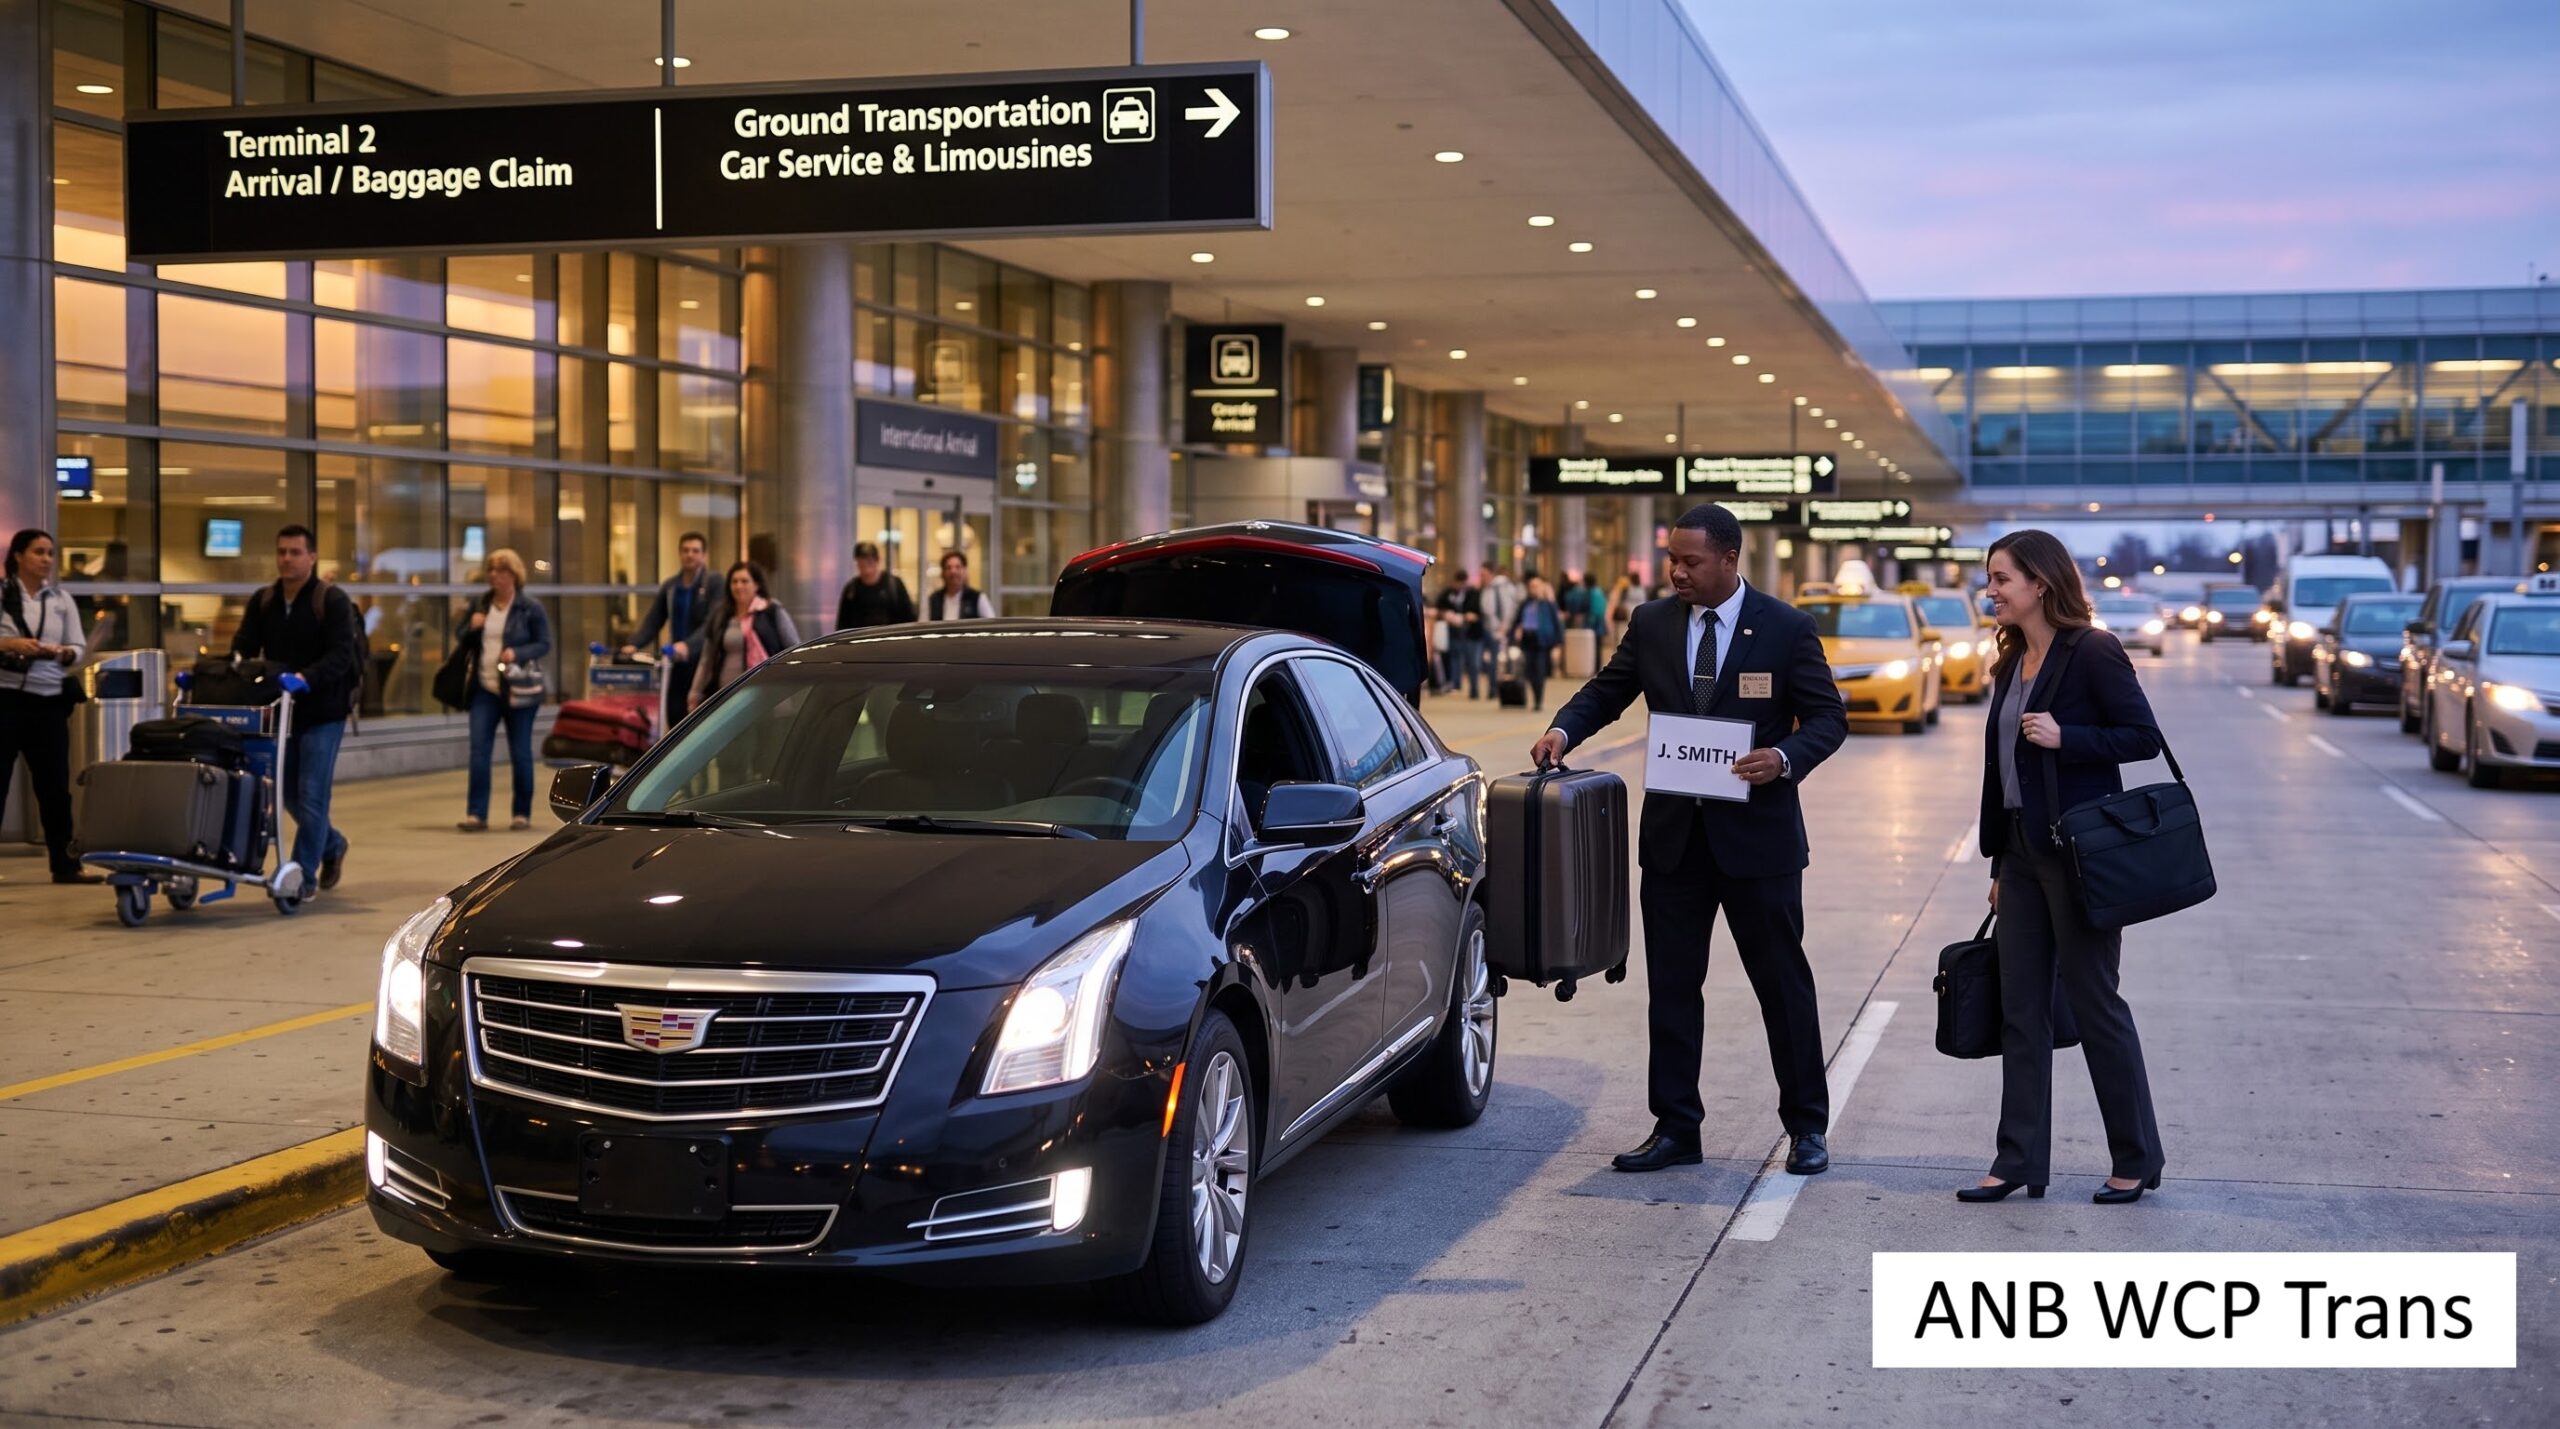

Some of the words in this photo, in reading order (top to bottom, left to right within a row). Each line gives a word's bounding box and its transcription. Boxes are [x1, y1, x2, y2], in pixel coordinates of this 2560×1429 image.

[734, 103, 851, 138] Ground
[857, 94, 1091, 137] Transportation
[223, 123, 350, 160] Terminal
[358, 124, 377, 154] 2
[720, 150, 771, 181] Car
[778, 144, 884, 179] Service
[892, 143, 916, 174] &
[924, 137, 1093, 173] Limousines
[224, 165, 323, 198] Arrival
[330, 165, 344, 195] /
[352, 162, 482, 200] Baggage
[488, 156, 573, 189] Claim
[881, 422, 944, 454] International
[1657, 743, 1671, 759] J.
[1677, 745, 1737, 766] SMITH
